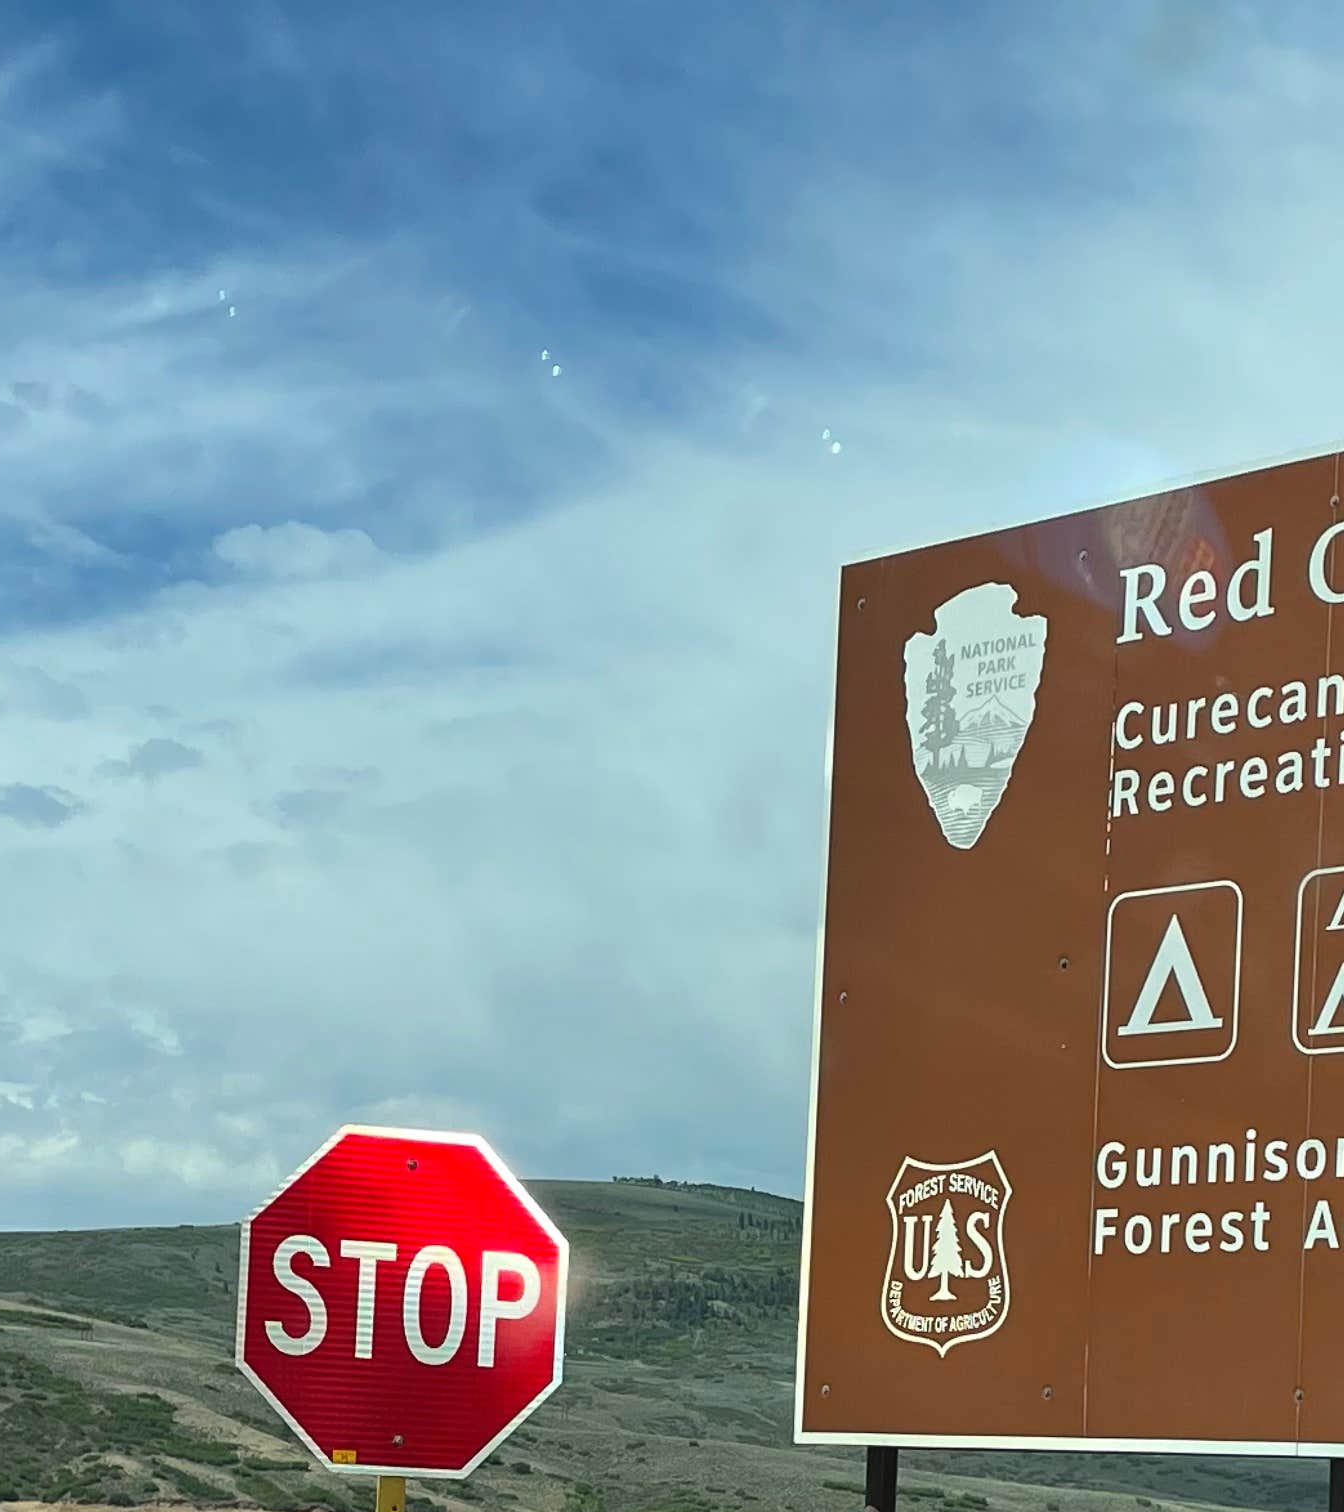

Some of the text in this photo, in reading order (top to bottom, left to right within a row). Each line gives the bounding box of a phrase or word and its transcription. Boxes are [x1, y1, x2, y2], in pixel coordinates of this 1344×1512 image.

[1116, 527, 1275, 644] Red
[960, 633, 1037, 660] NATIONAL
[977, 656, 1016, 676] PARK
[965, 673, 1026, 698] SERVICE
[898, 1173, 999, 1215] FOREST SERVICE
[1094, 1201, 1271, 1255] Forest
[264, 1234, 541, 1368] STOP
[889, 1275, 1002, 1333] DEPARTMENT OF AGRICULTURE
